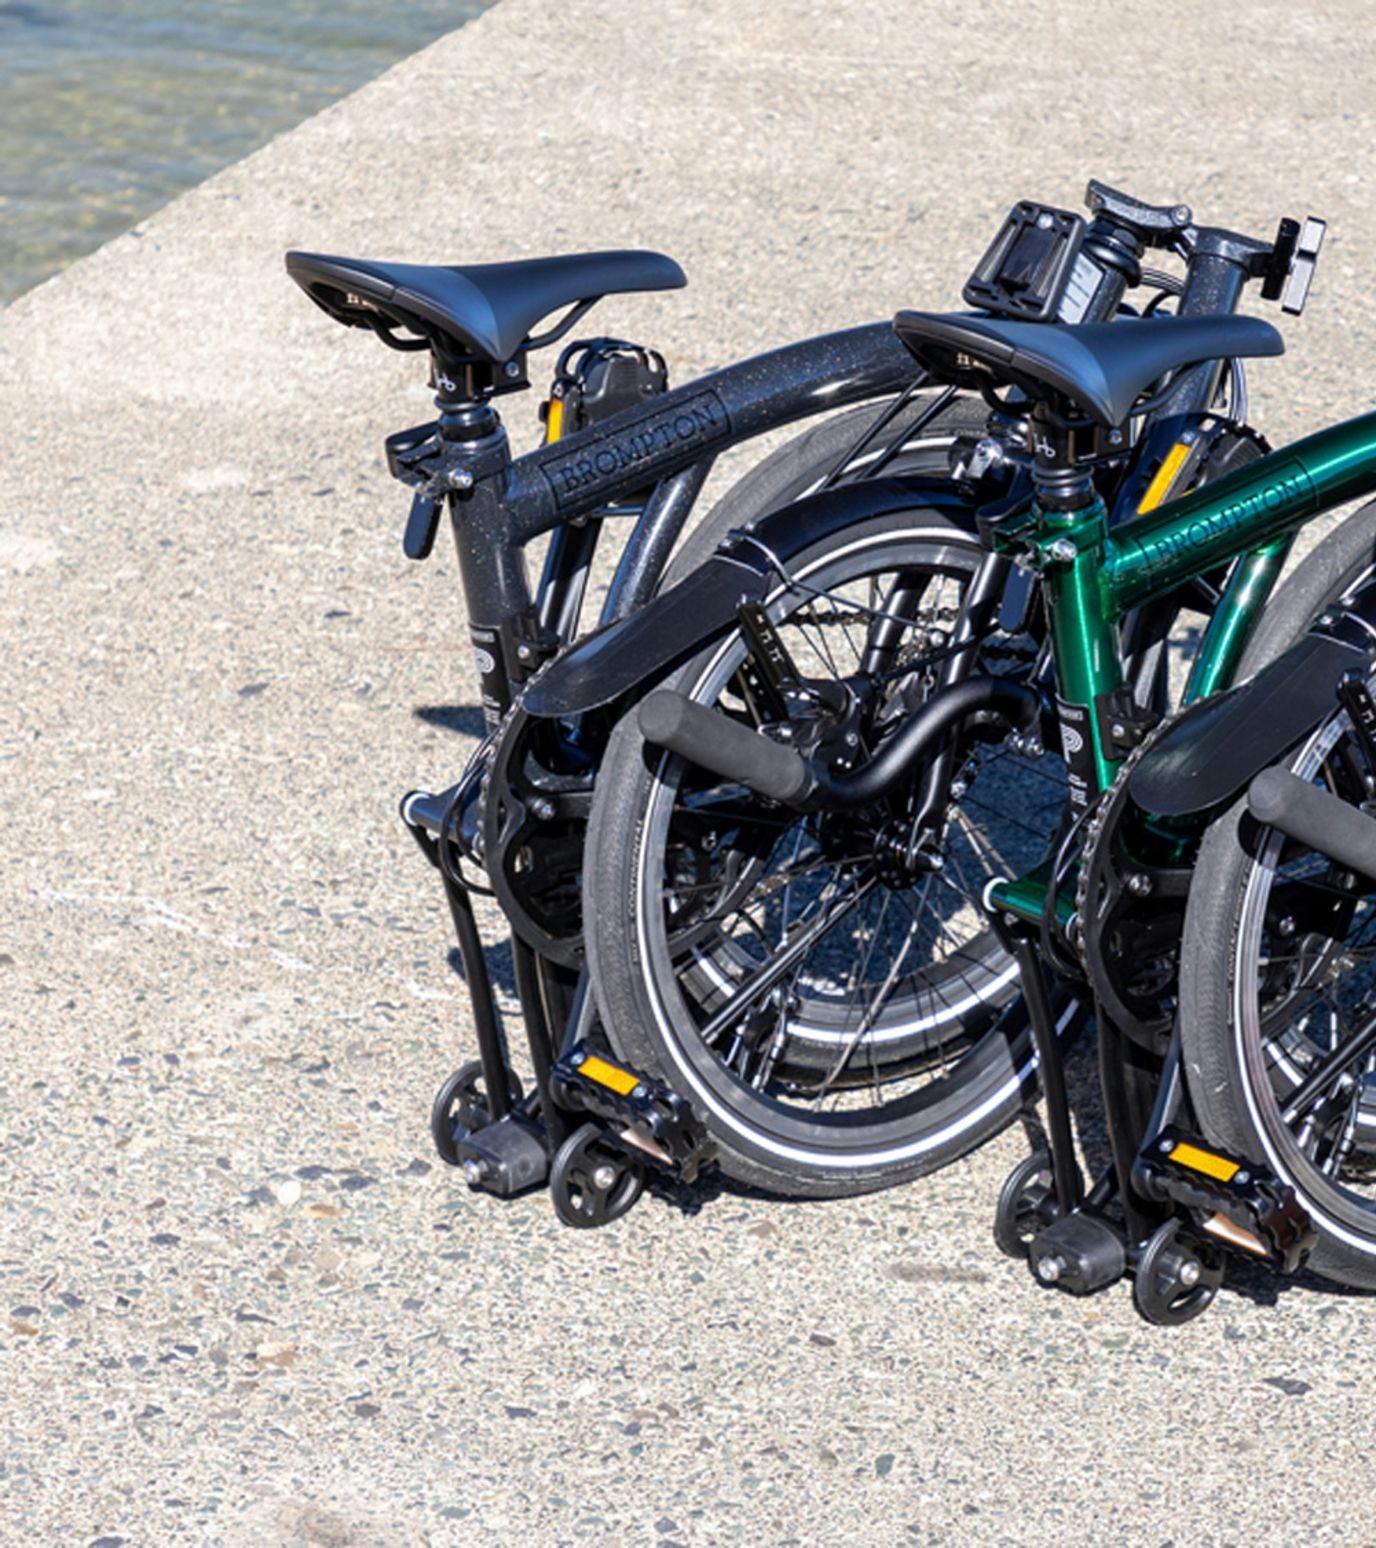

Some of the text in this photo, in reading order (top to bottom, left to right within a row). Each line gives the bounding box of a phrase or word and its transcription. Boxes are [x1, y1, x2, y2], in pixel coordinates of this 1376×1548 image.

[559, 403, 718, 492] BROMPTON
[1154, 474, 1310, 566] BROMPTON
[1059, 722, 1084, 764] P
